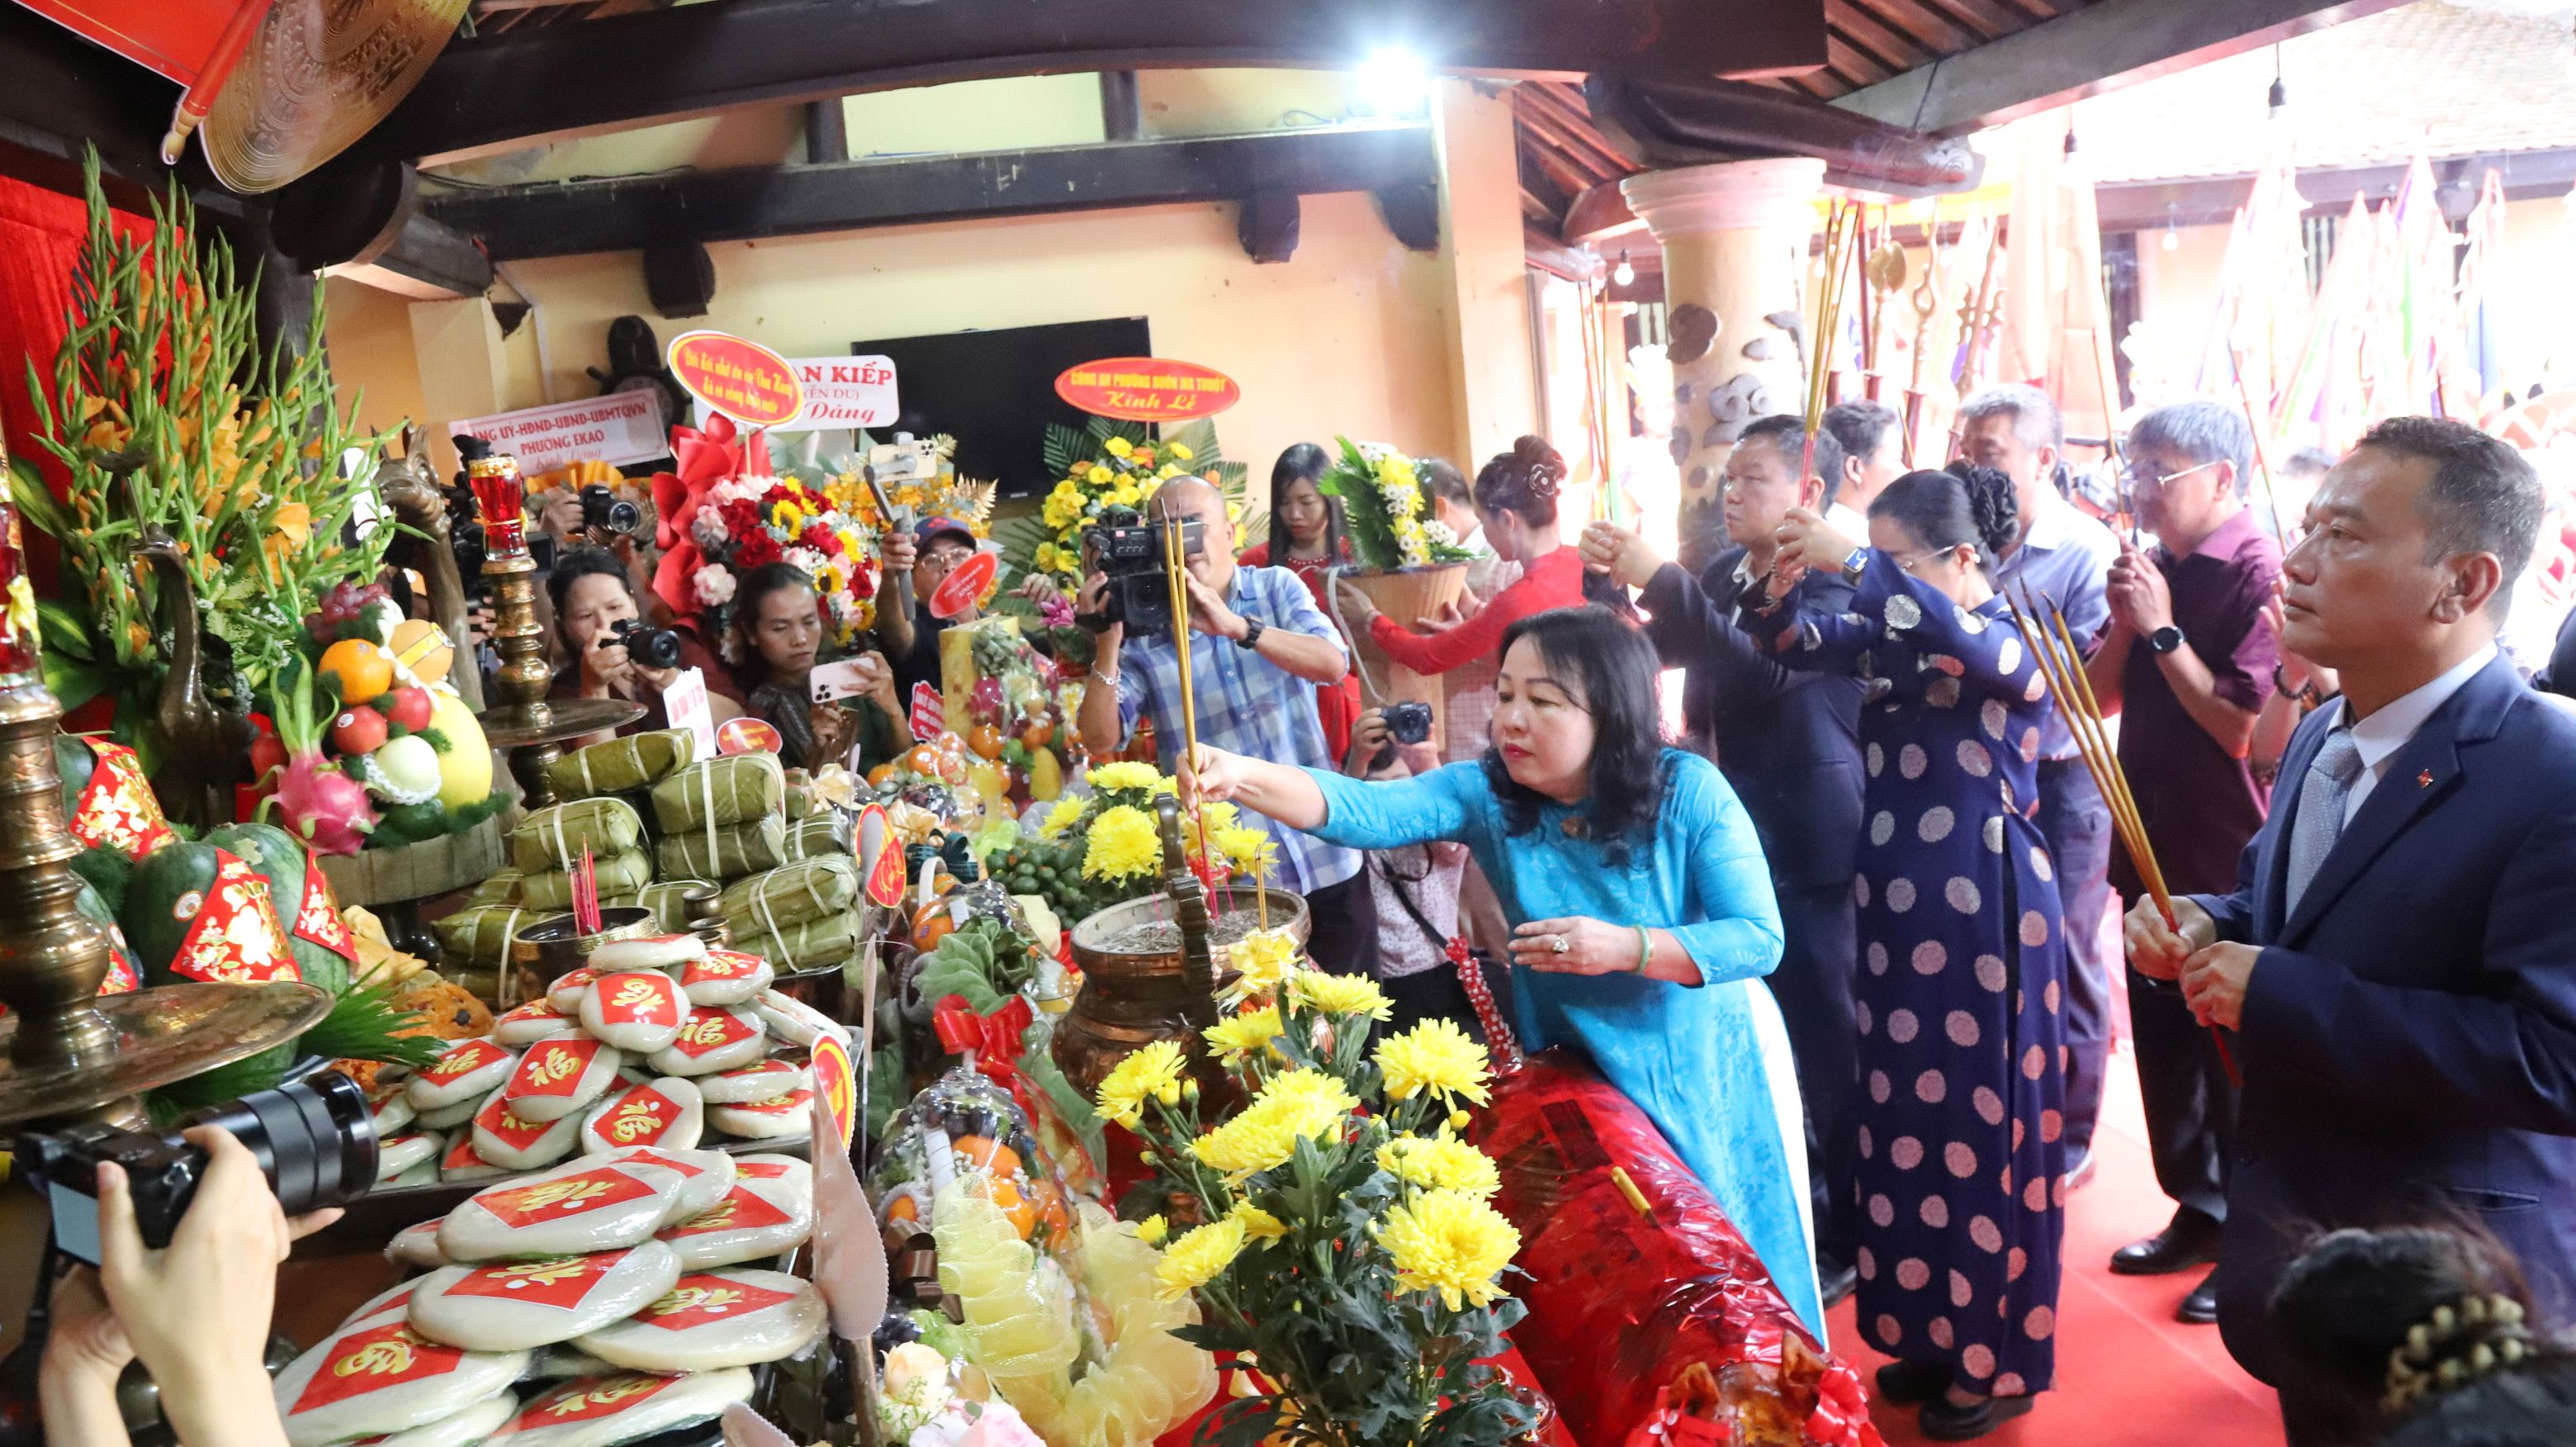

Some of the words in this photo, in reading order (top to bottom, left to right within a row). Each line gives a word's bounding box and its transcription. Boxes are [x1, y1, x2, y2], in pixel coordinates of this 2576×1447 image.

[831, 361, 893, 385] KIẾP
[1071, 371, 1097, 387] CÔNG
[1099, 373, 1111, 387] AN
[804, 401, 877, 424] Dâng
[471, 427, 498, 441] ẢNG
